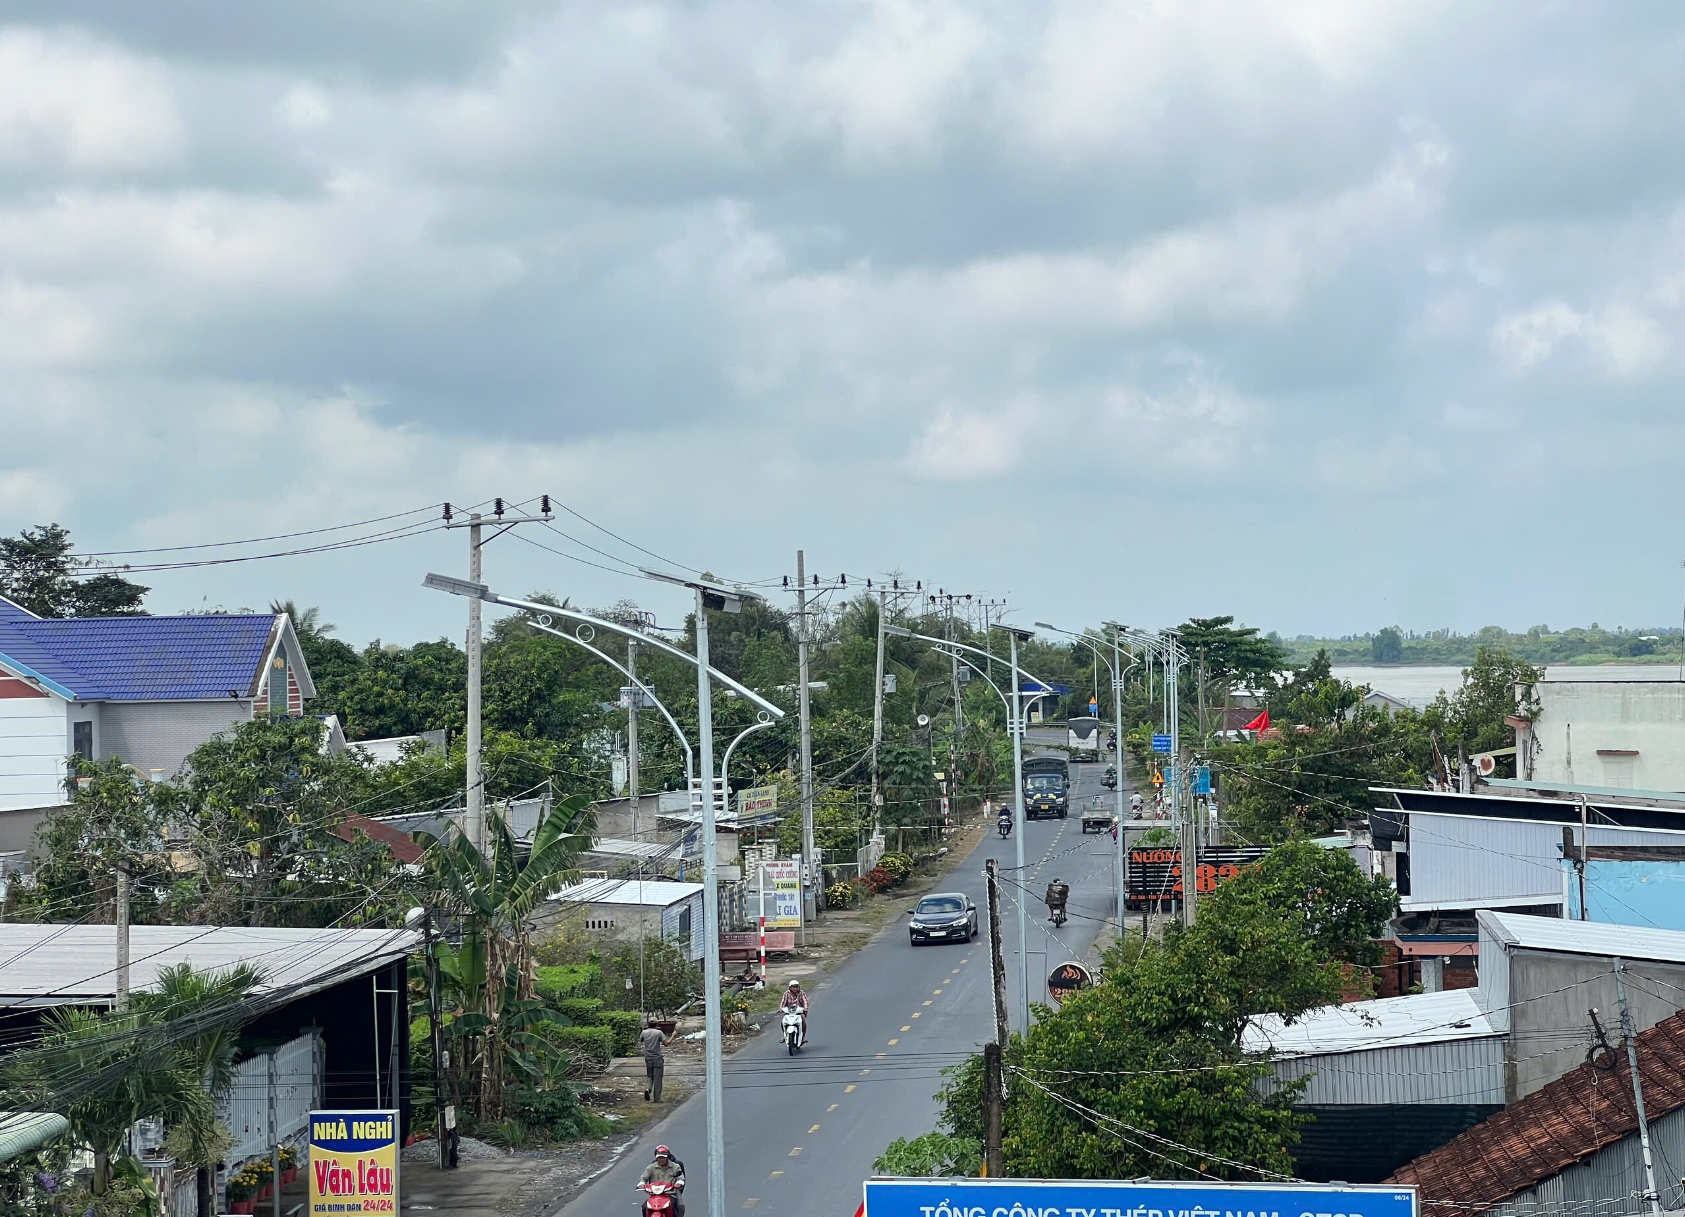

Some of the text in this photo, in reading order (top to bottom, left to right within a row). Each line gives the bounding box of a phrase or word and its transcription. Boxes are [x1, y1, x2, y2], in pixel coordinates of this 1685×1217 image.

[784, 905, 798, 916] GIA
[313, 1116, 393, 1140] NHÀ NGHỈ
[314, 1158, 355, 1196] Vân
[363, 1199, 393, 1211] 24/24
[919, 1198, 986, 1217] TỔNG
